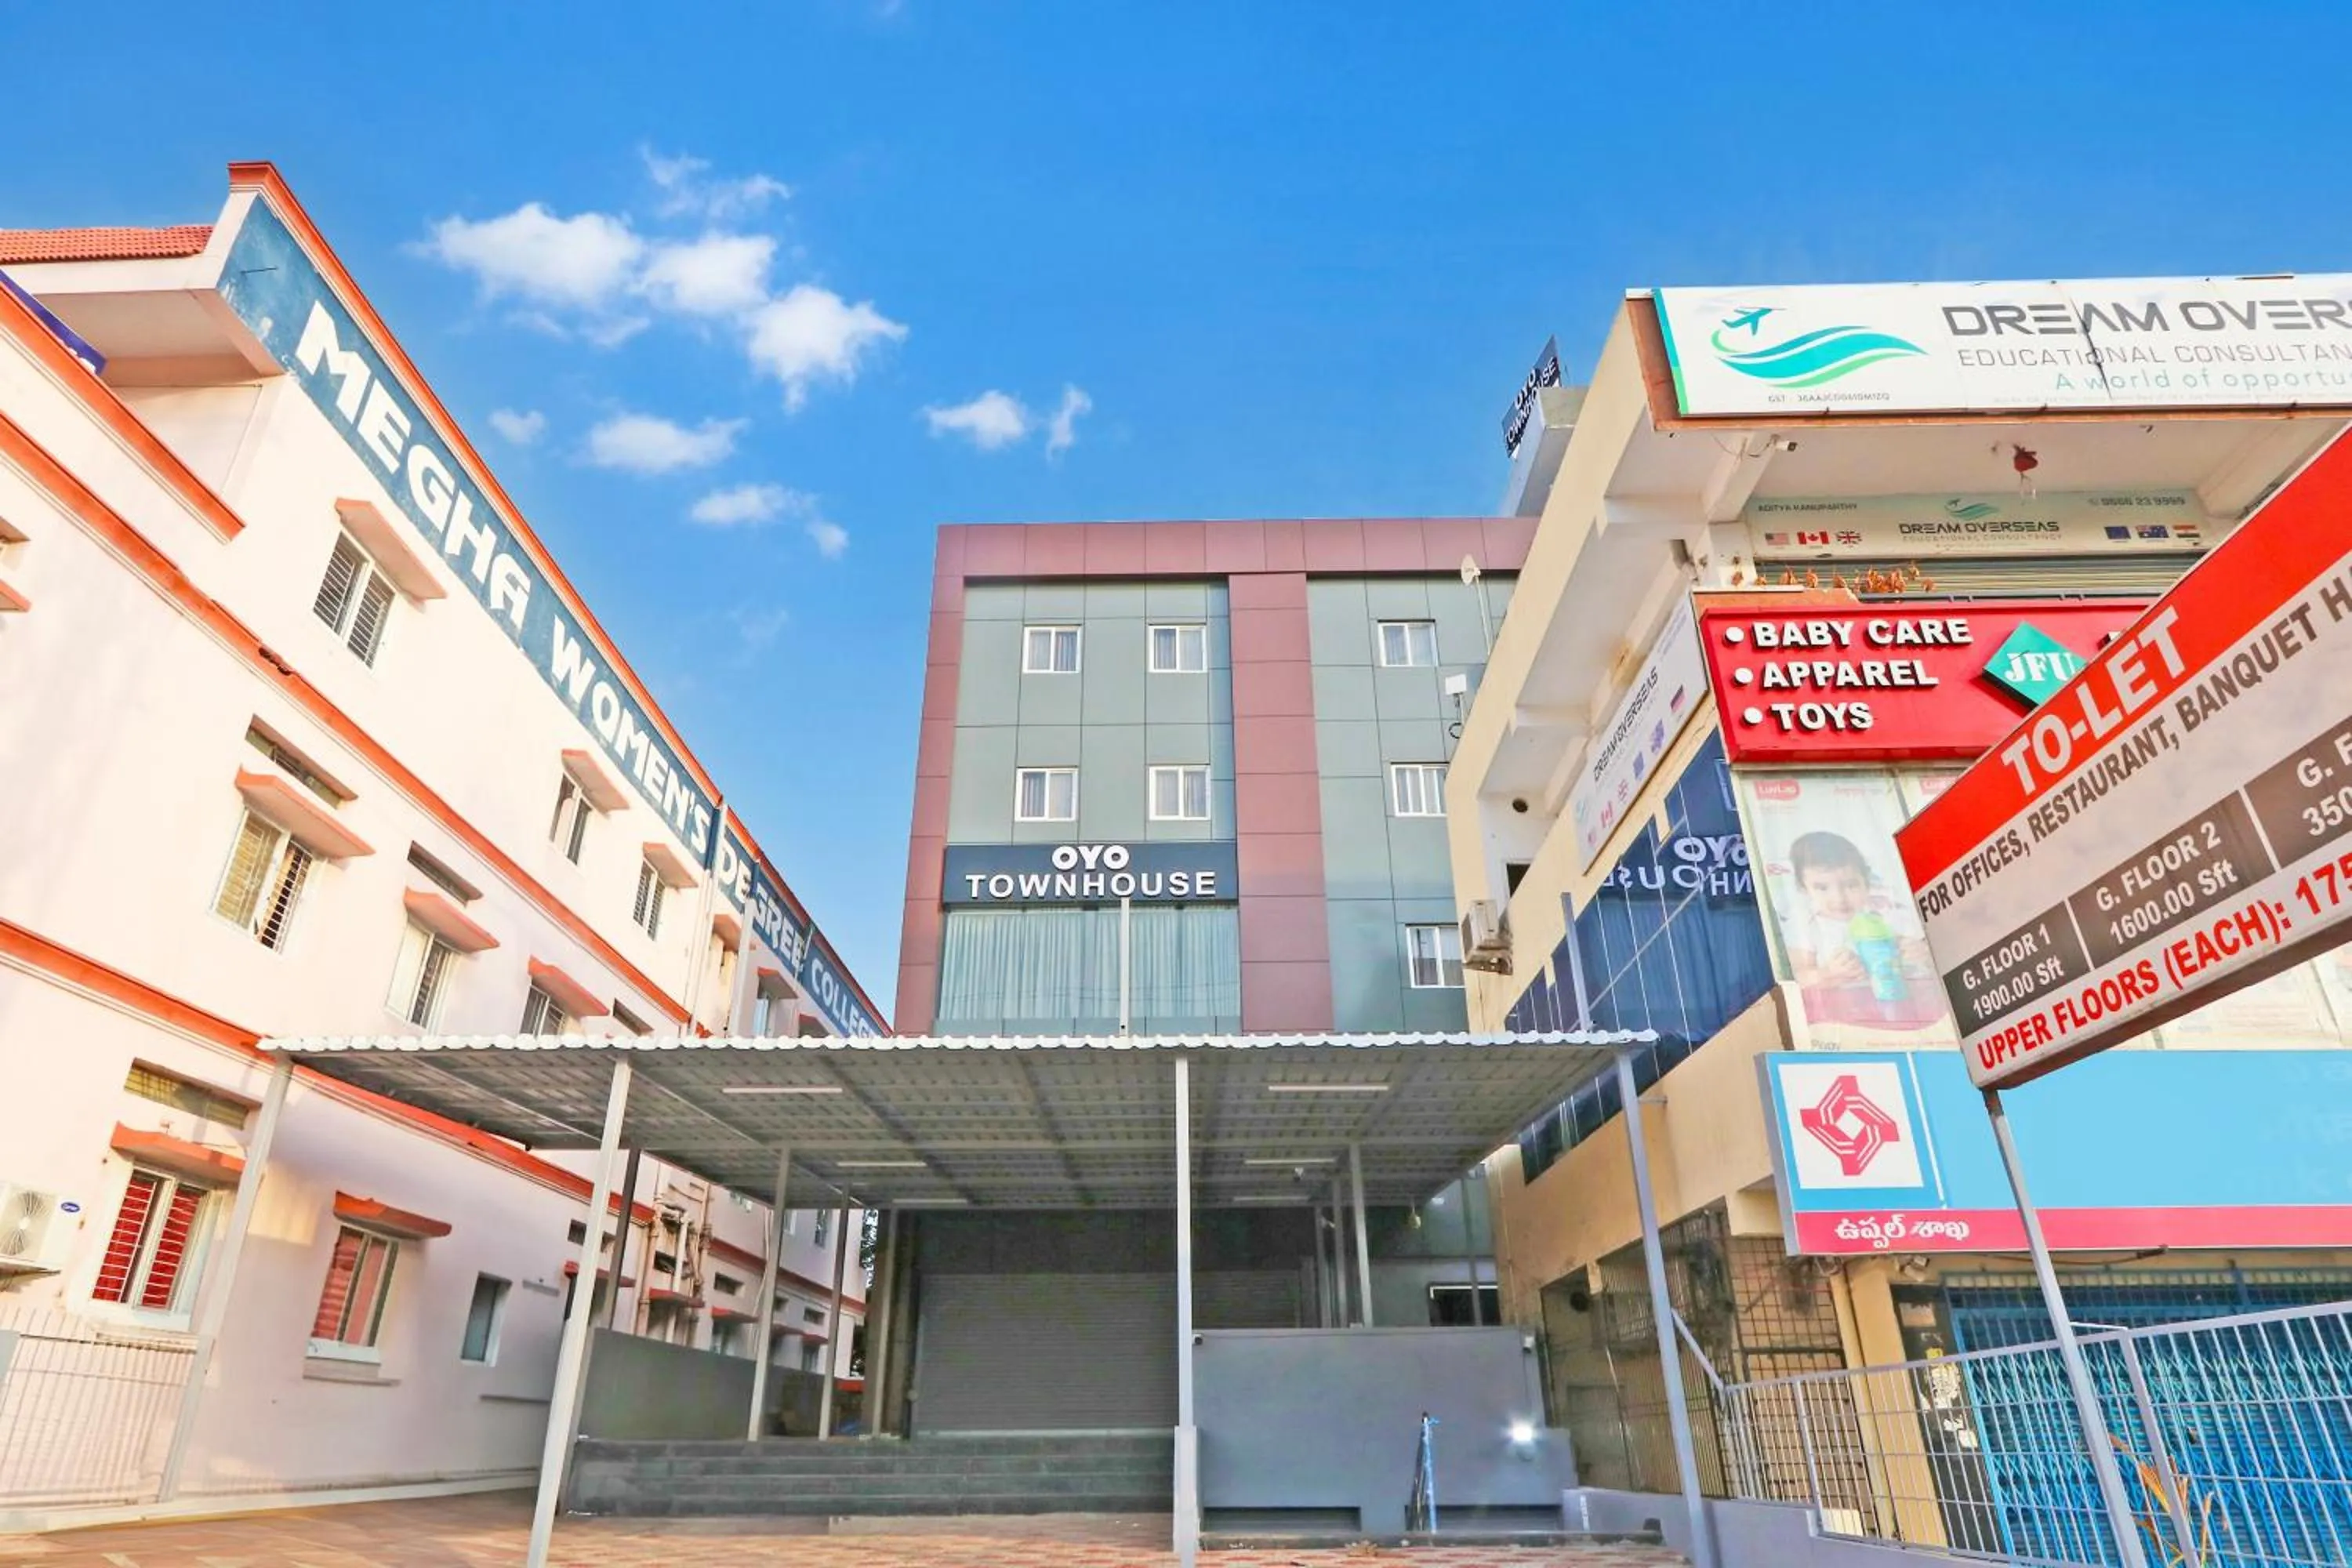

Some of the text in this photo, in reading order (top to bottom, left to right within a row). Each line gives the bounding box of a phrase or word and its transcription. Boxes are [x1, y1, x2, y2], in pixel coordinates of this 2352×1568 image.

[1942, 299, 2352, 336] DREAM OVER
[1958, 346, 2167, 366] EDUCATIONAL
[1514, 368, 1536, 409] OYO
[2056, 367, 2352, 394] A world of opportu
[1899, 521, 2060, 535] DREAM OVERSEAS
[1753, 618, 1973, 649] BABY CARE
[296, 300, 532, 630] MEGHA
[550, 615, 712, 855] WOMEN'S
[811, 957, 877, 1038] COLLEG
[1762, 659, 1940, 689] APPAREL
[2004, 651, 2078, 683] JFU
[1770, 702, 1874, 731] TOYS
[2001, 606, 2190, 797] TO-LET
[1593, 666, 1659, 782] DREAM OVERSEAS
[1918, 564, 2352, 923] FOR OFFICES, RESTAURANT, BANQUET H
[2296, 757, 2335, 789] G.
[1051, 844, 1130, 871] OYO
[2096, 821, 2222, 912] G. FLOOR 2
[965, 871, 1217, 898] TOWNHOUSE
[2109, 858, 2238, 946] 1600.00 Sft
[1962, 922, 2052, 990] G. FLOOR 1
[1972, 954, 2065, 1020] 1900.00 Sft
[1976, 1011, 2054, 1070] UPPER
[2052, 959, 2160, 1036] FLOORS
[2163, 898, 2292, 991] (EACH):
[1835, 1213, 1970, 1249] ఉప్పల్ శాఖ
